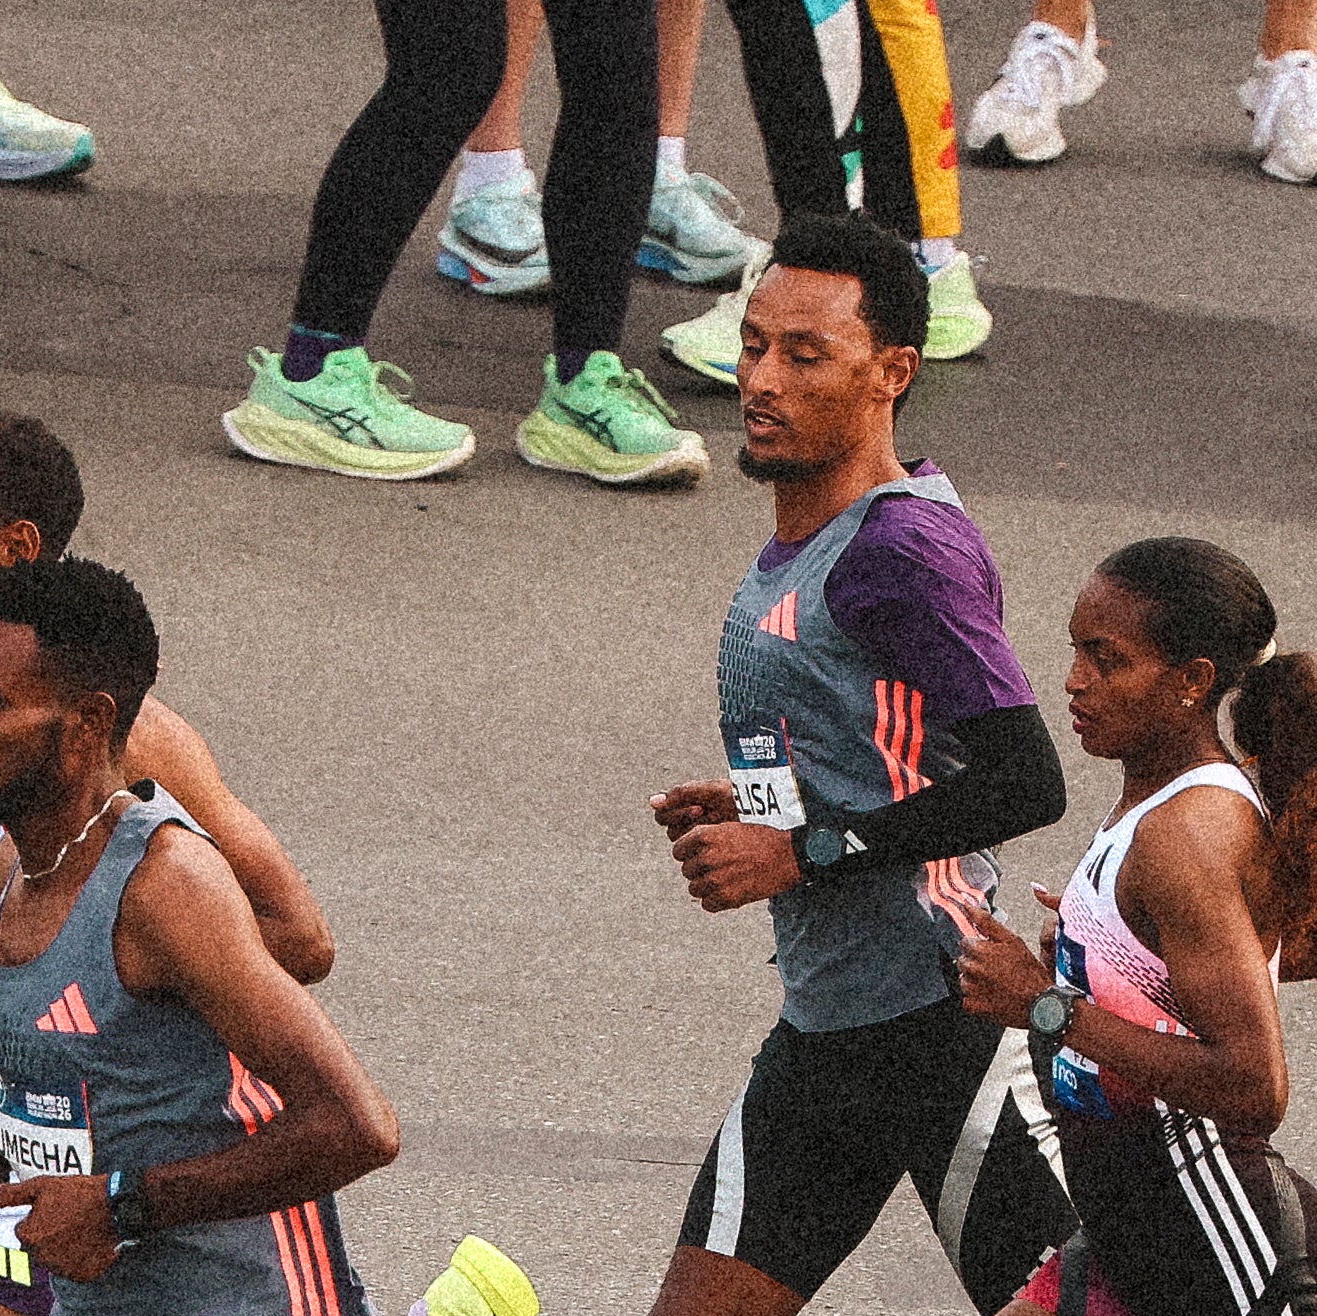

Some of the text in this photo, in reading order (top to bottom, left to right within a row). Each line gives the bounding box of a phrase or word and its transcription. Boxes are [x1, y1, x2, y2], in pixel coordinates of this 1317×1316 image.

[763, 735, 775, 748] 20
[765, 748, 777, 760] 26
[55, 1095, 71, 1109] 20
[57, 1107, 72, 1121] 26
